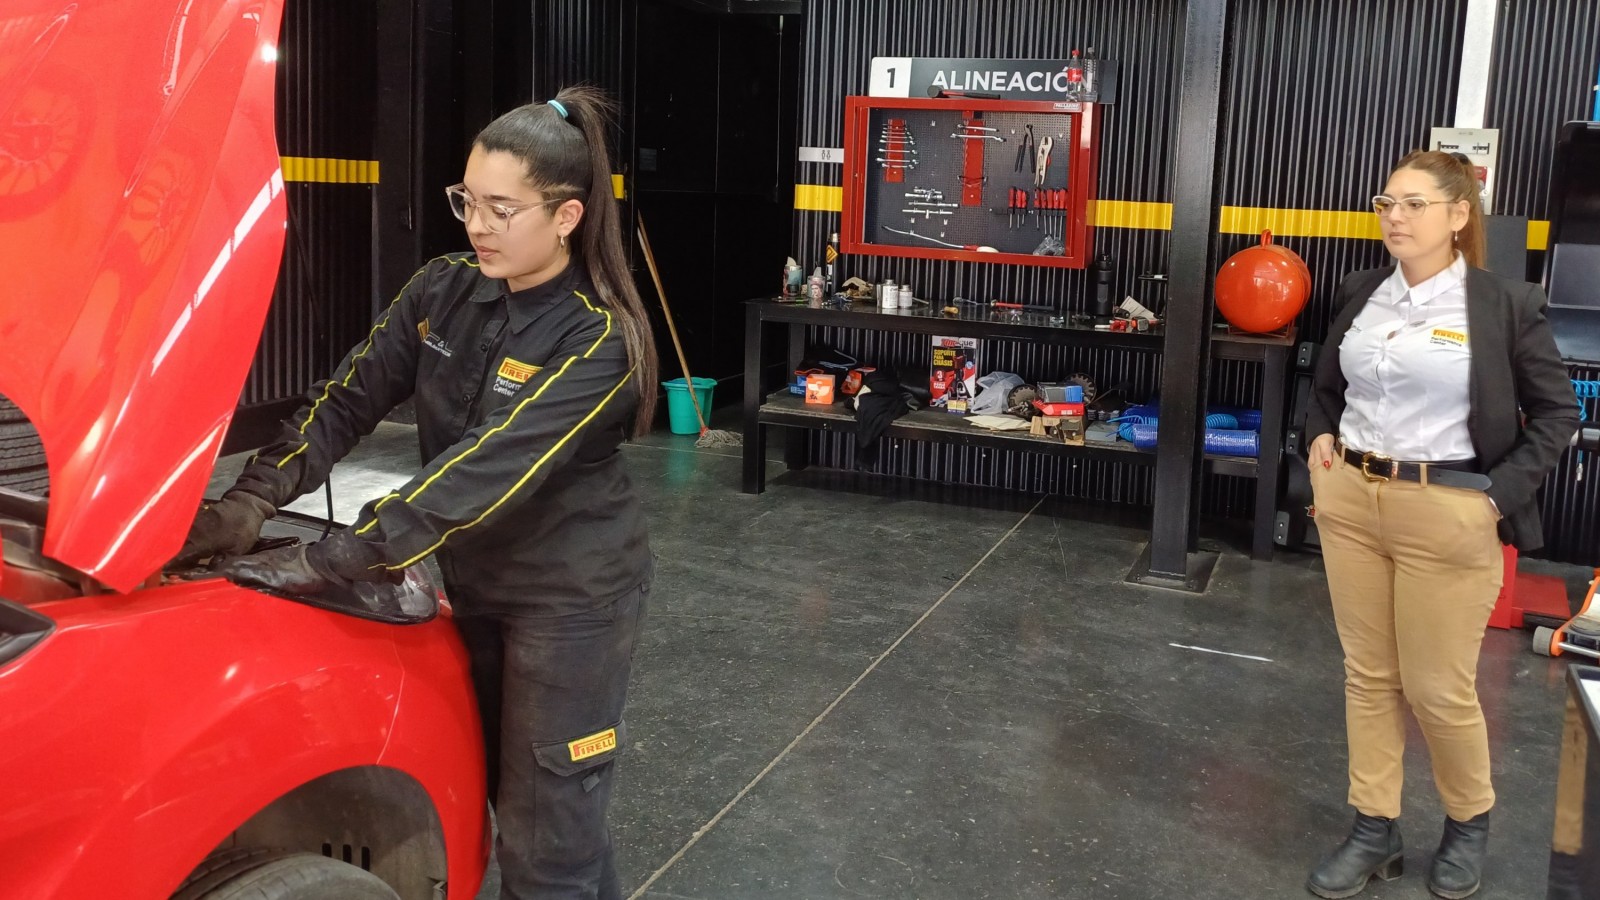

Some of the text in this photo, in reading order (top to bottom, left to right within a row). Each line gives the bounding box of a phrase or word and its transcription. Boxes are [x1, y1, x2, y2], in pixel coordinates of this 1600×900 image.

[887, 67, 896, 88] 1
[493, 383, 515, 397] Center
[572, 732, 615, 757] PIRELLI
